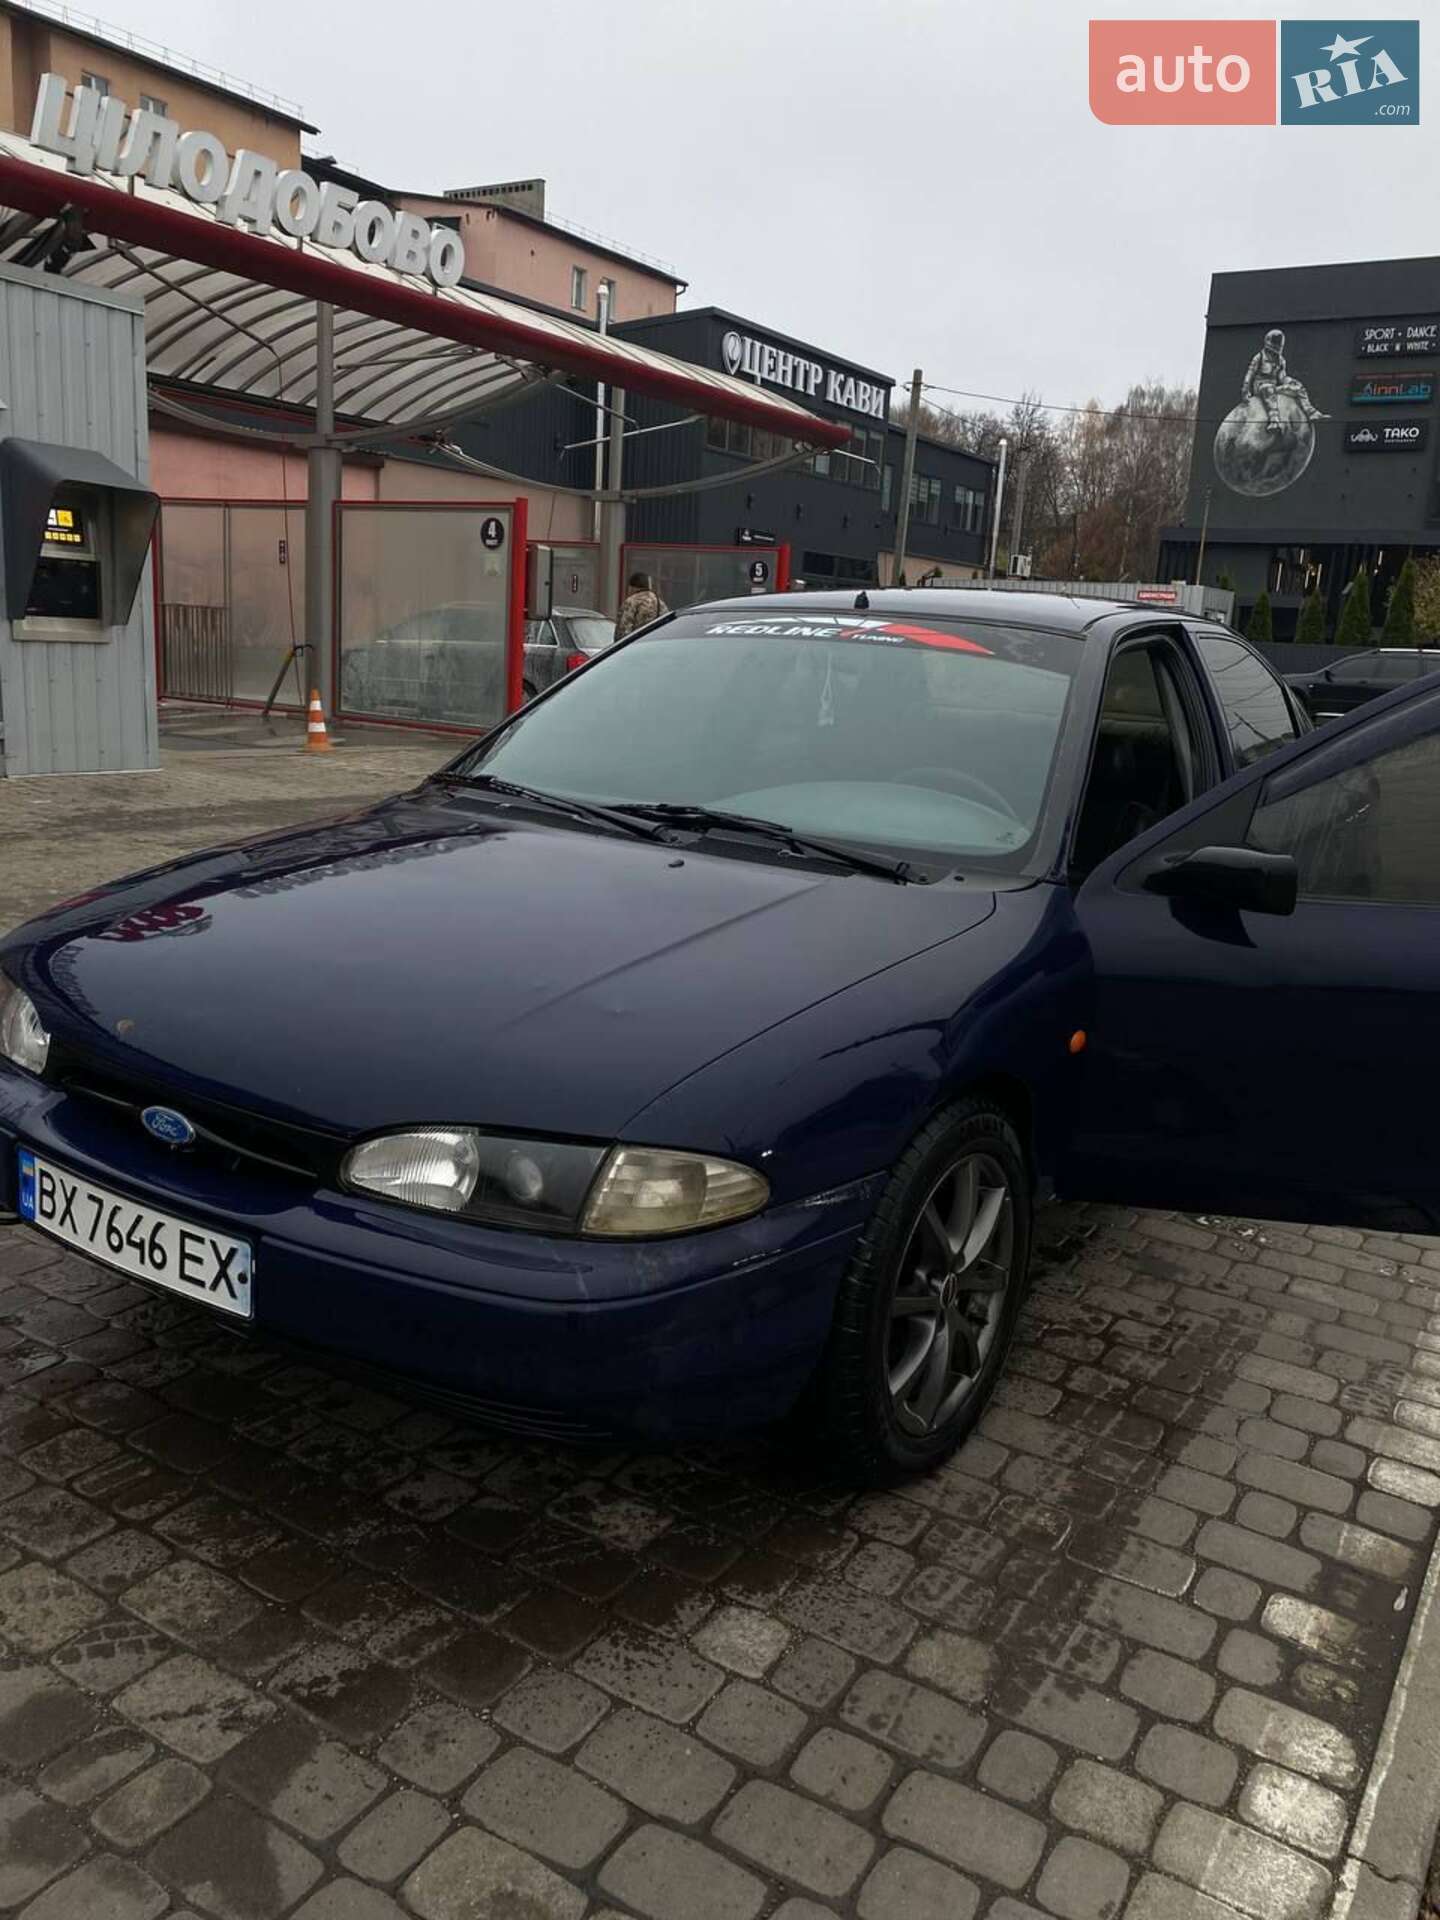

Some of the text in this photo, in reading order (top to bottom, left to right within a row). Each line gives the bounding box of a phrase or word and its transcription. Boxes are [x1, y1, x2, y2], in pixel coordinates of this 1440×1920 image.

[30, 72, 466, 289] ЦІЛОДОБОВО
[1364, 325, 1438, 341] SPORT DANCE
[740, 336, 886, 419] ЦЕНТР КАВИ
[1384, 427, 1420, 439] TAKO
[488, 520, 497, 538] 4
[755, 563, 763, 577] 5
[705, 623, 842, 638] REDLINE
[87, 1193, 168, 1271] 7646
